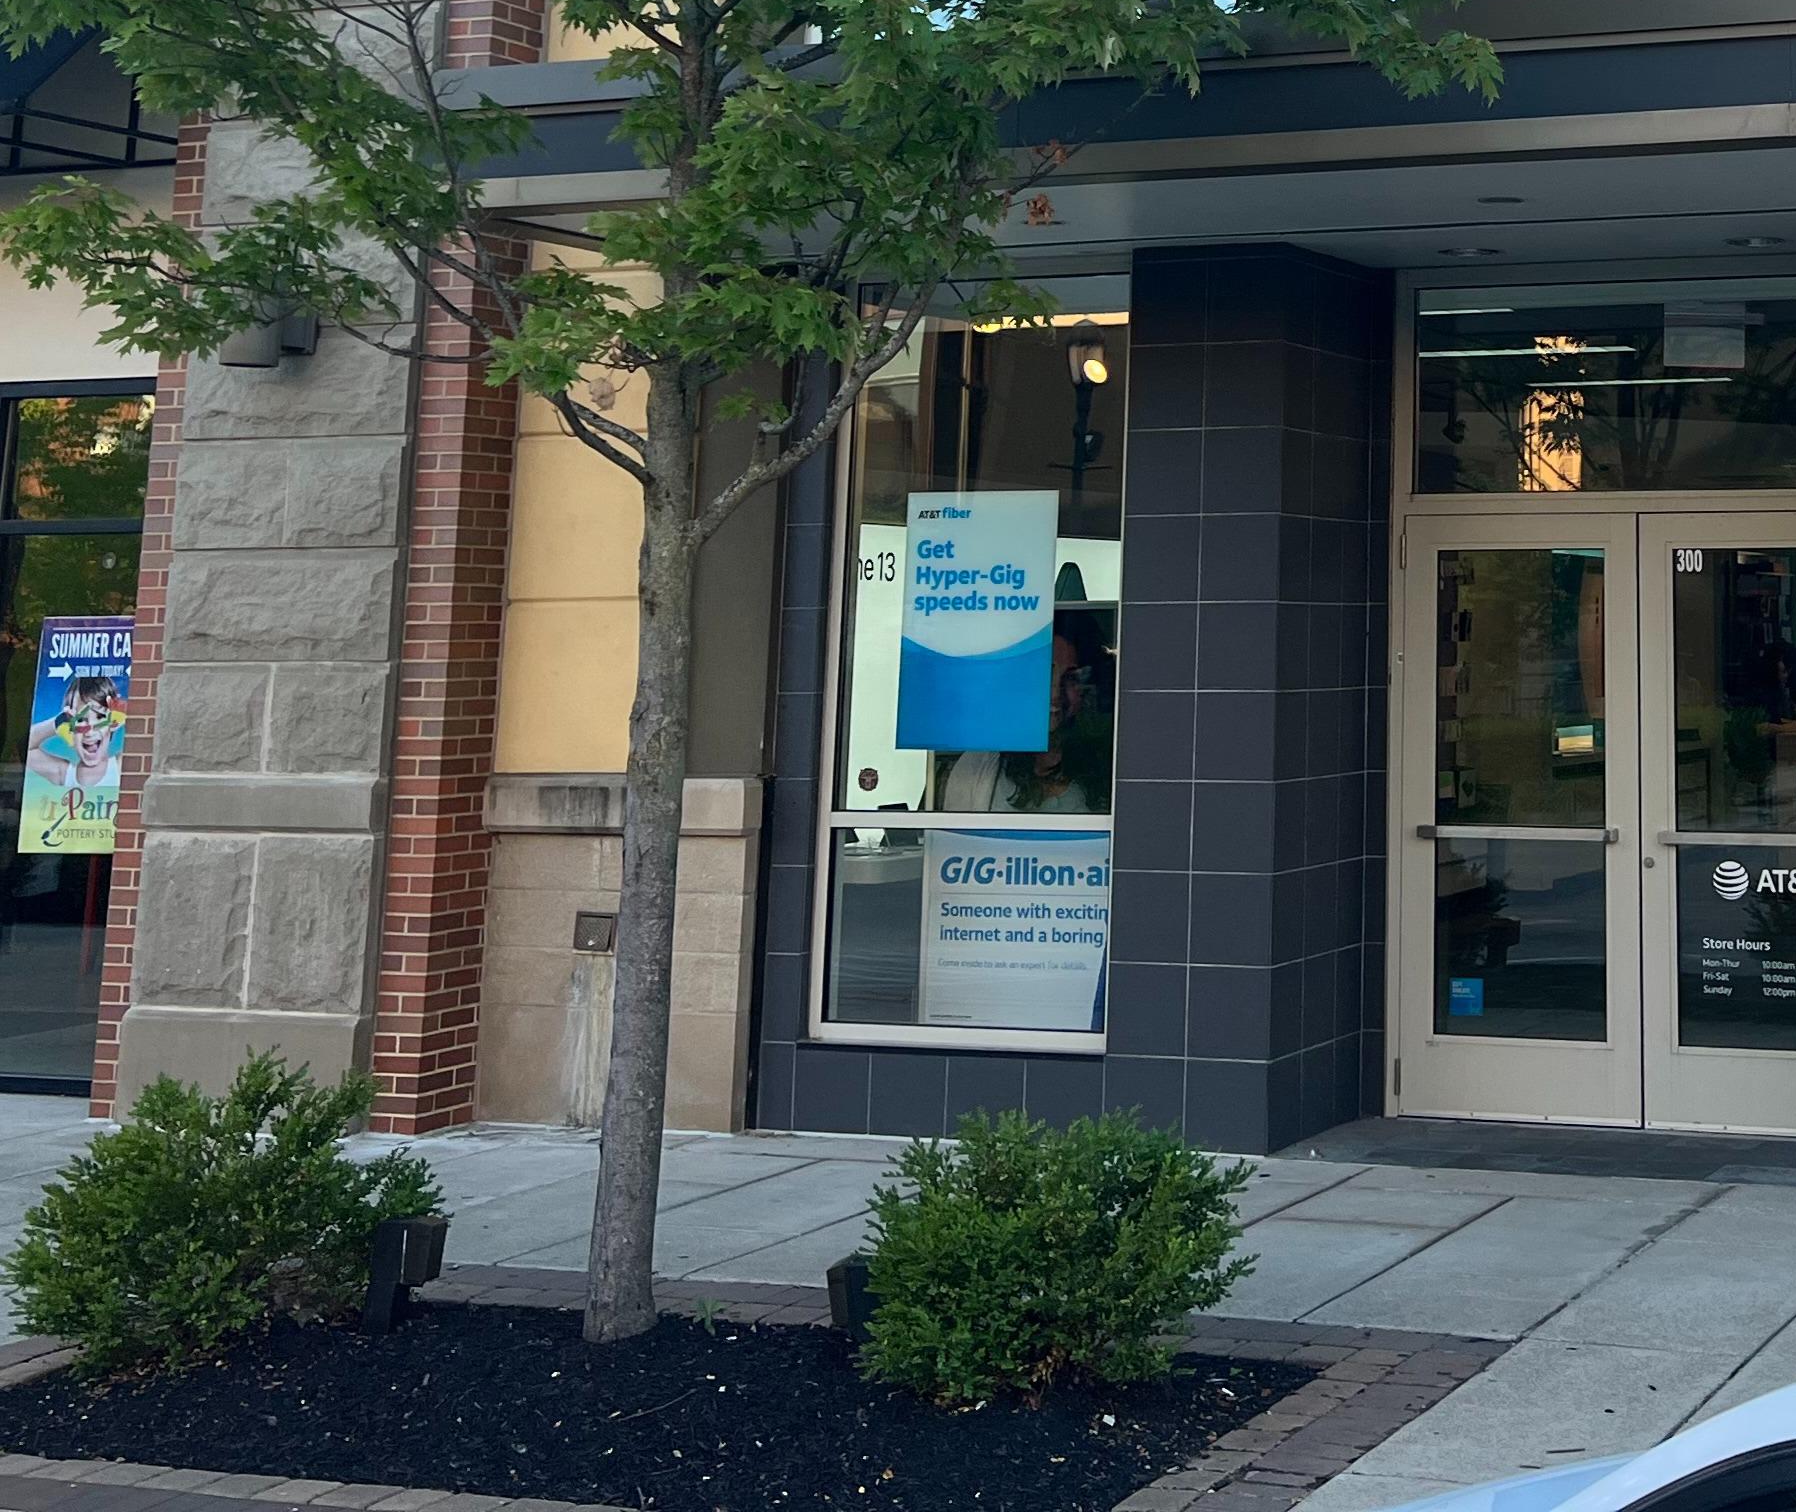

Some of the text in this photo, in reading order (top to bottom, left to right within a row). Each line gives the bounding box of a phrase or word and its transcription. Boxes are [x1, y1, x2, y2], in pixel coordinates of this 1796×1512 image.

[918, 507, 972, 520] AT&T fiber
[917, 540, 956, 560] Get
[877, 551, 896, 582] 13
[1676, 549, 1703, 573] 300
[916, 563, 1026, 591] Hyper-Gig
[914, 591, 1041, 617] speeds now
[49, 632, 131, 658] SUMMER CA
[57, 828, 97, 839] POTTERY
[941, 902, 1012, 919] Someone
[1016, 902, 1051, 919] with
[1005, 926, 1034, 943] and
[1038, 932, 1048, 943] a
[1052, 927, 1104, 948] boring
[1702, 938, 1771, 951] Store Hours
[1702, 958, 1740, 968] Mon-Thur
[1762, 960, 1796, 970] 10:00am
[1703, 972, 1730, 982] Fri-Sat
[1762, 973, 1796, 984] 10:00am
[1703, 985, 1733, 997] Sunday
[1763, 987, 1796, 999] 12:00pm
